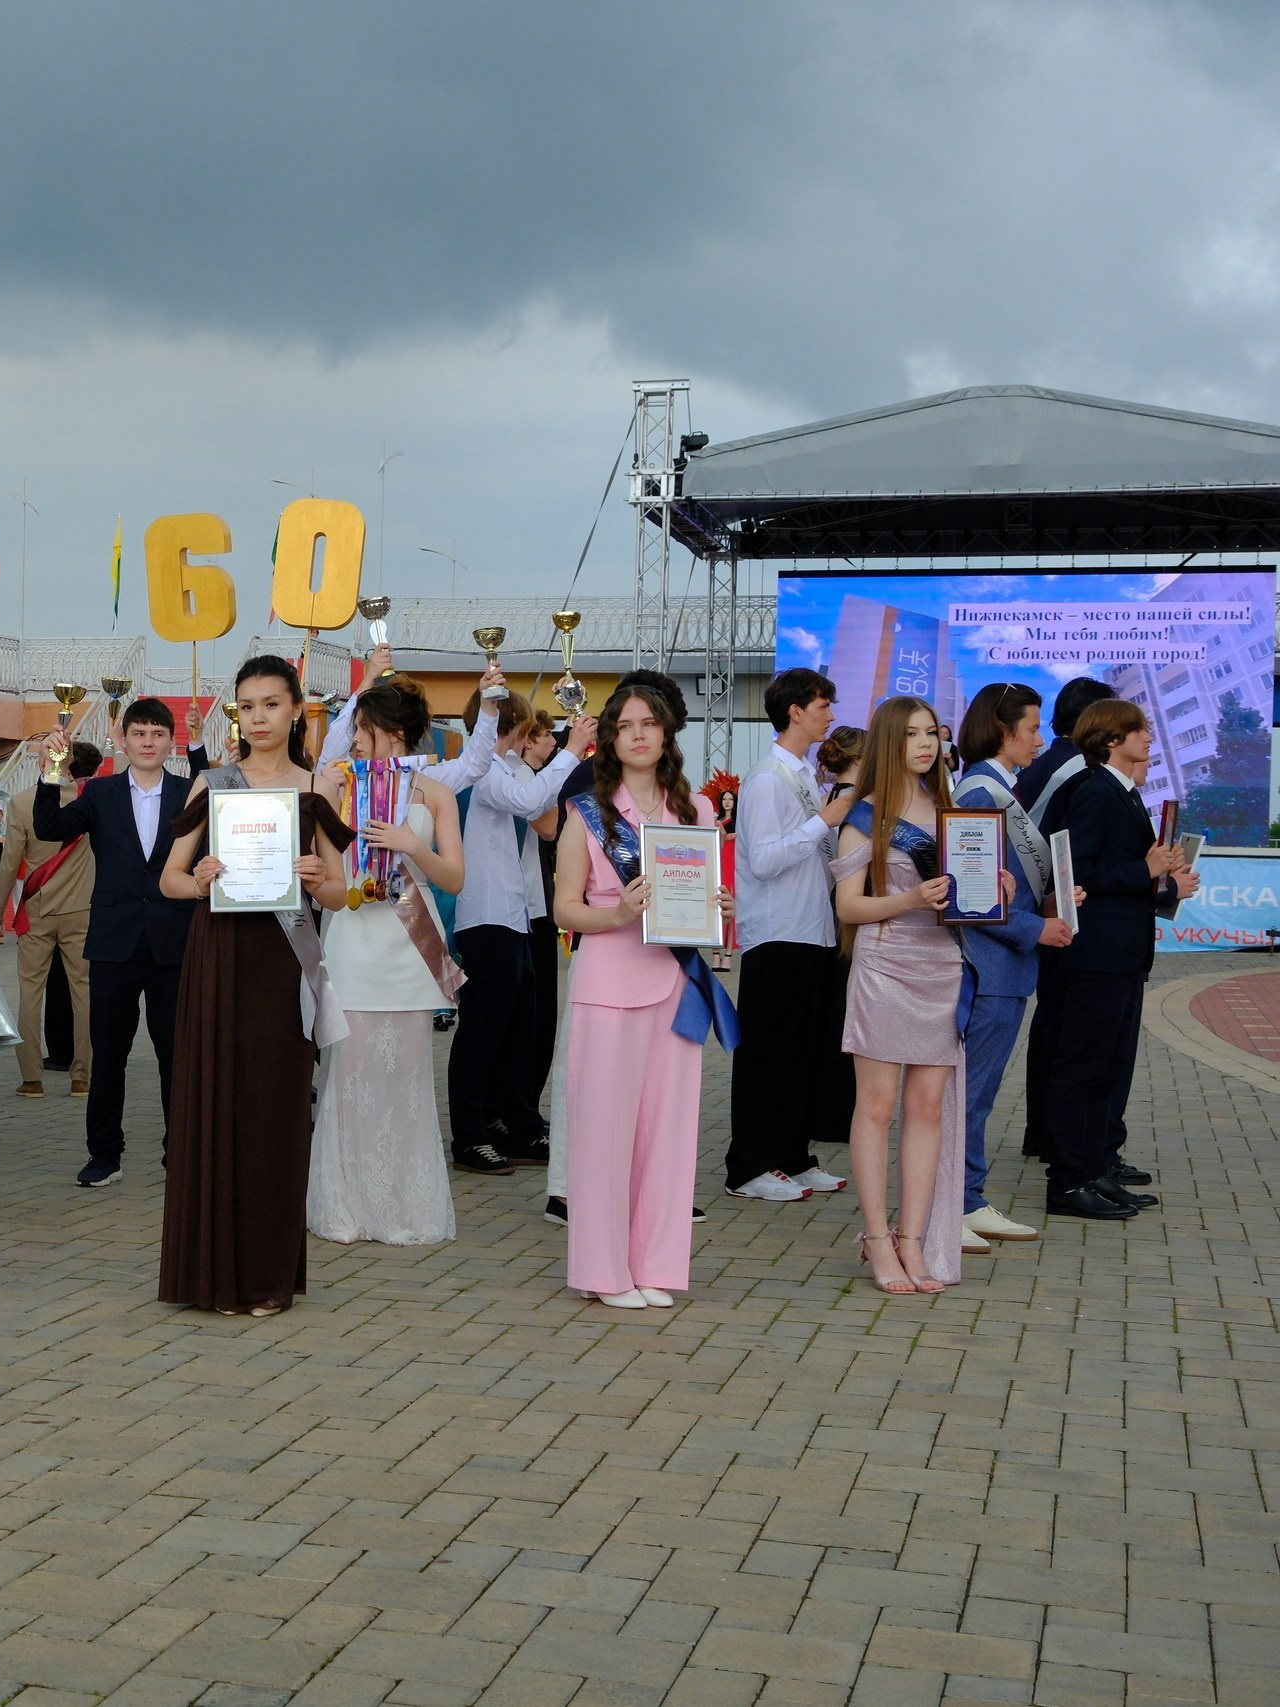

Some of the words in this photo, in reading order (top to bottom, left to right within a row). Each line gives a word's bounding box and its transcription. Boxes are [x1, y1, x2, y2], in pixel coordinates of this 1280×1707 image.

[955, 608, 1063, 621] Нижнекамск
[1083, 610, 1131, 621] место
[1136, 607, 1192, 621] нашей
[1198, 606, 1250, 620] силы!
[1026, 627, 1056, 641] Мы
[1061, 627, 1098, 641] тебя
[1103, 627, 1169, 641] любим!
[899, 647, 930, 668] НК
[989, 646, 1001, 660] С
[1007, 647, 1080, 660] юбилеем
[1086, 647, 1146, 664] родной
[1152, 646, 1206, 663] город!
[896, 676, 928, 696] 60
[231, 822, 277, 836] ДИПЛОМ
[662, 869, 702, 879] ДИПЛОМ
